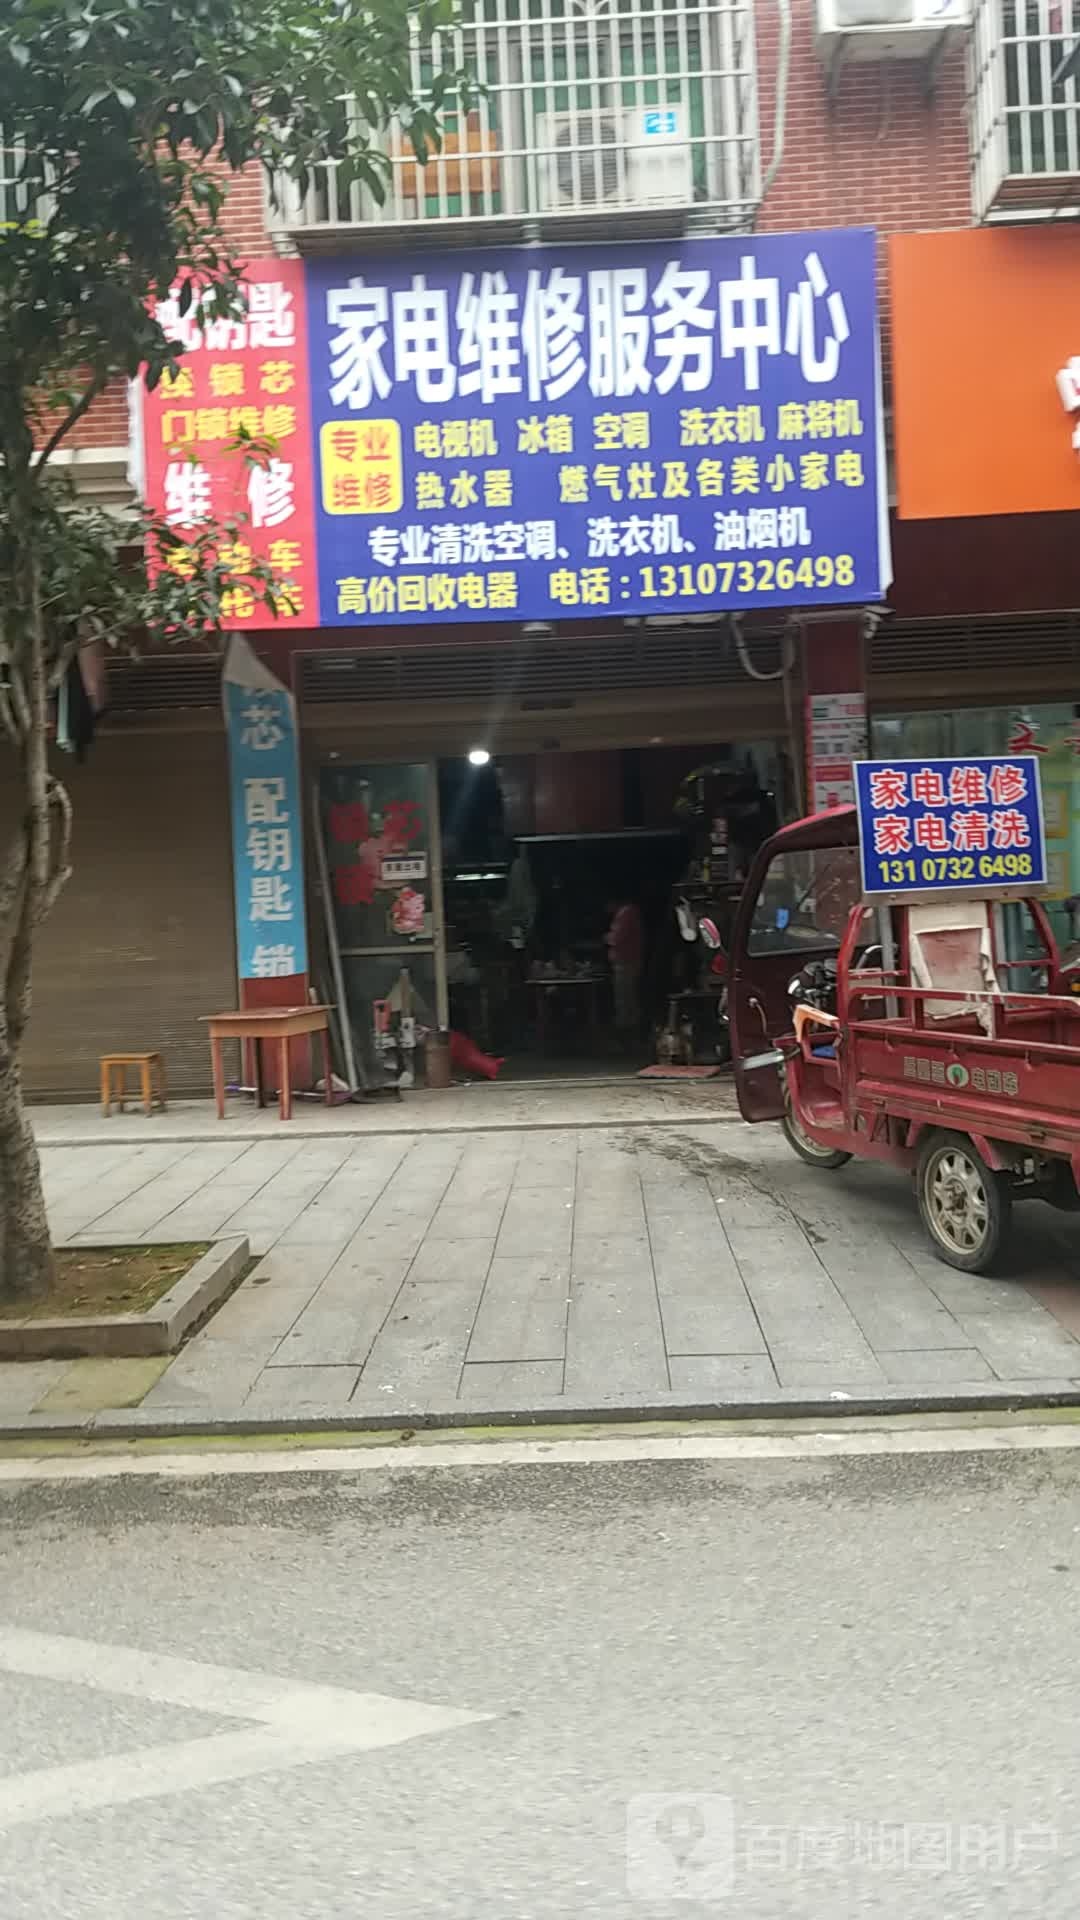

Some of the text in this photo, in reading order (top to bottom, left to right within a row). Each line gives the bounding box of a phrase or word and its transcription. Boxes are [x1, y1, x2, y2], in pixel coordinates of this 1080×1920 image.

[326, 252, 850, 410] 家电维修服务中心
[328, 424, 393, 463] 专业
[413, 398, 864, 459] 电视机 冰箱 空调 洗衣机 麻将机
[163, 458, 296, 531] 维修
[331, 471, 393, 508] 维修
[415, 449, 865, 511] 热水器 燃气灶及各类小家电
[335, 570, 519, 615] 高价回收电器
[239, 688, 285, 752] 芯
[869, 764, 1029, 811] 家电维修
[243, 777, 293, 923] 配钥匙
[872, 808, 1032, 855] 家电清洗
